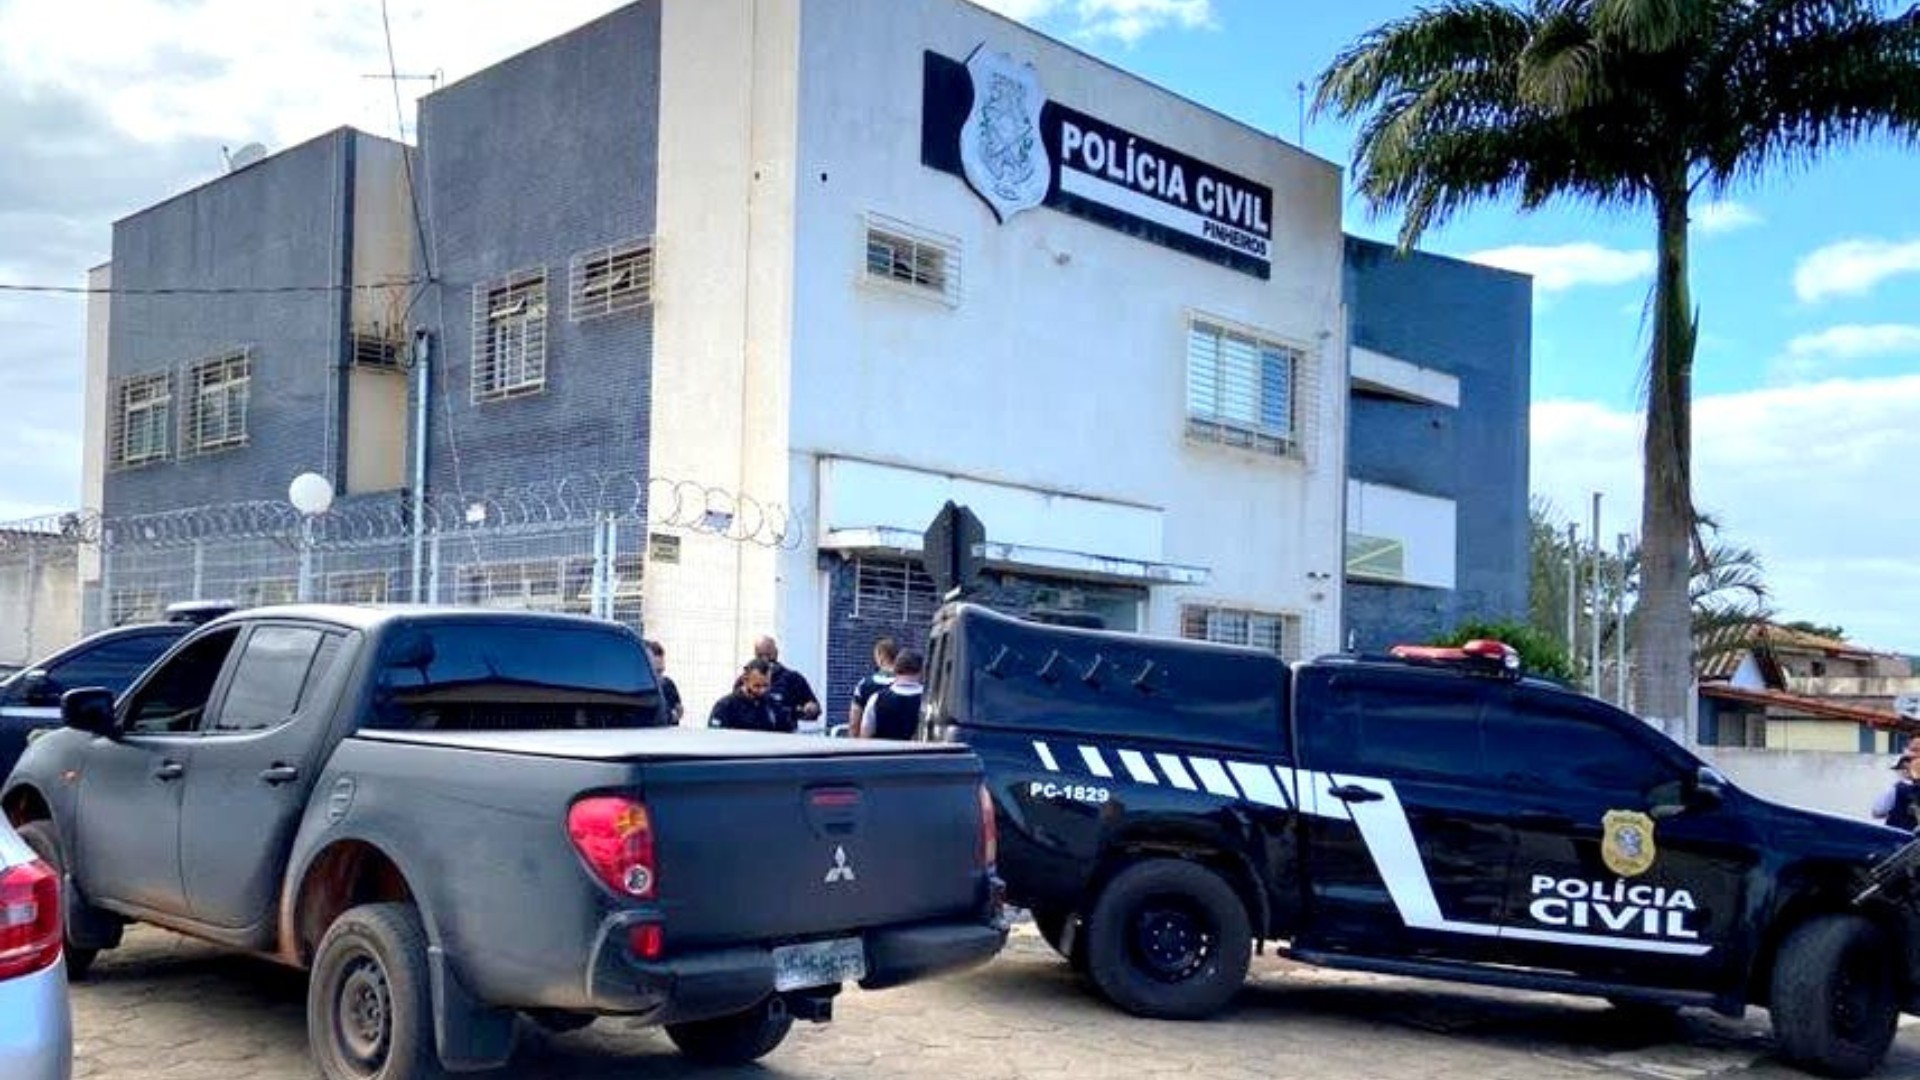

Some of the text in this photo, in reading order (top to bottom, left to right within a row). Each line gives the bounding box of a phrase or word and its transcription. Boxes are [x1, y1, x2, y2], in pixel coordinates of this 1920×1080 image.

[1062, 121, 1269, 232] POLÍCIA CIVIL
[1203, 220, 1267, 256] PINHEIROS
[1030, 782, 1109, 803] PC-1829
[1531, 874, 1697, 910] POLÍCIA
[1529, 897, 1698, 938] CIVIL
